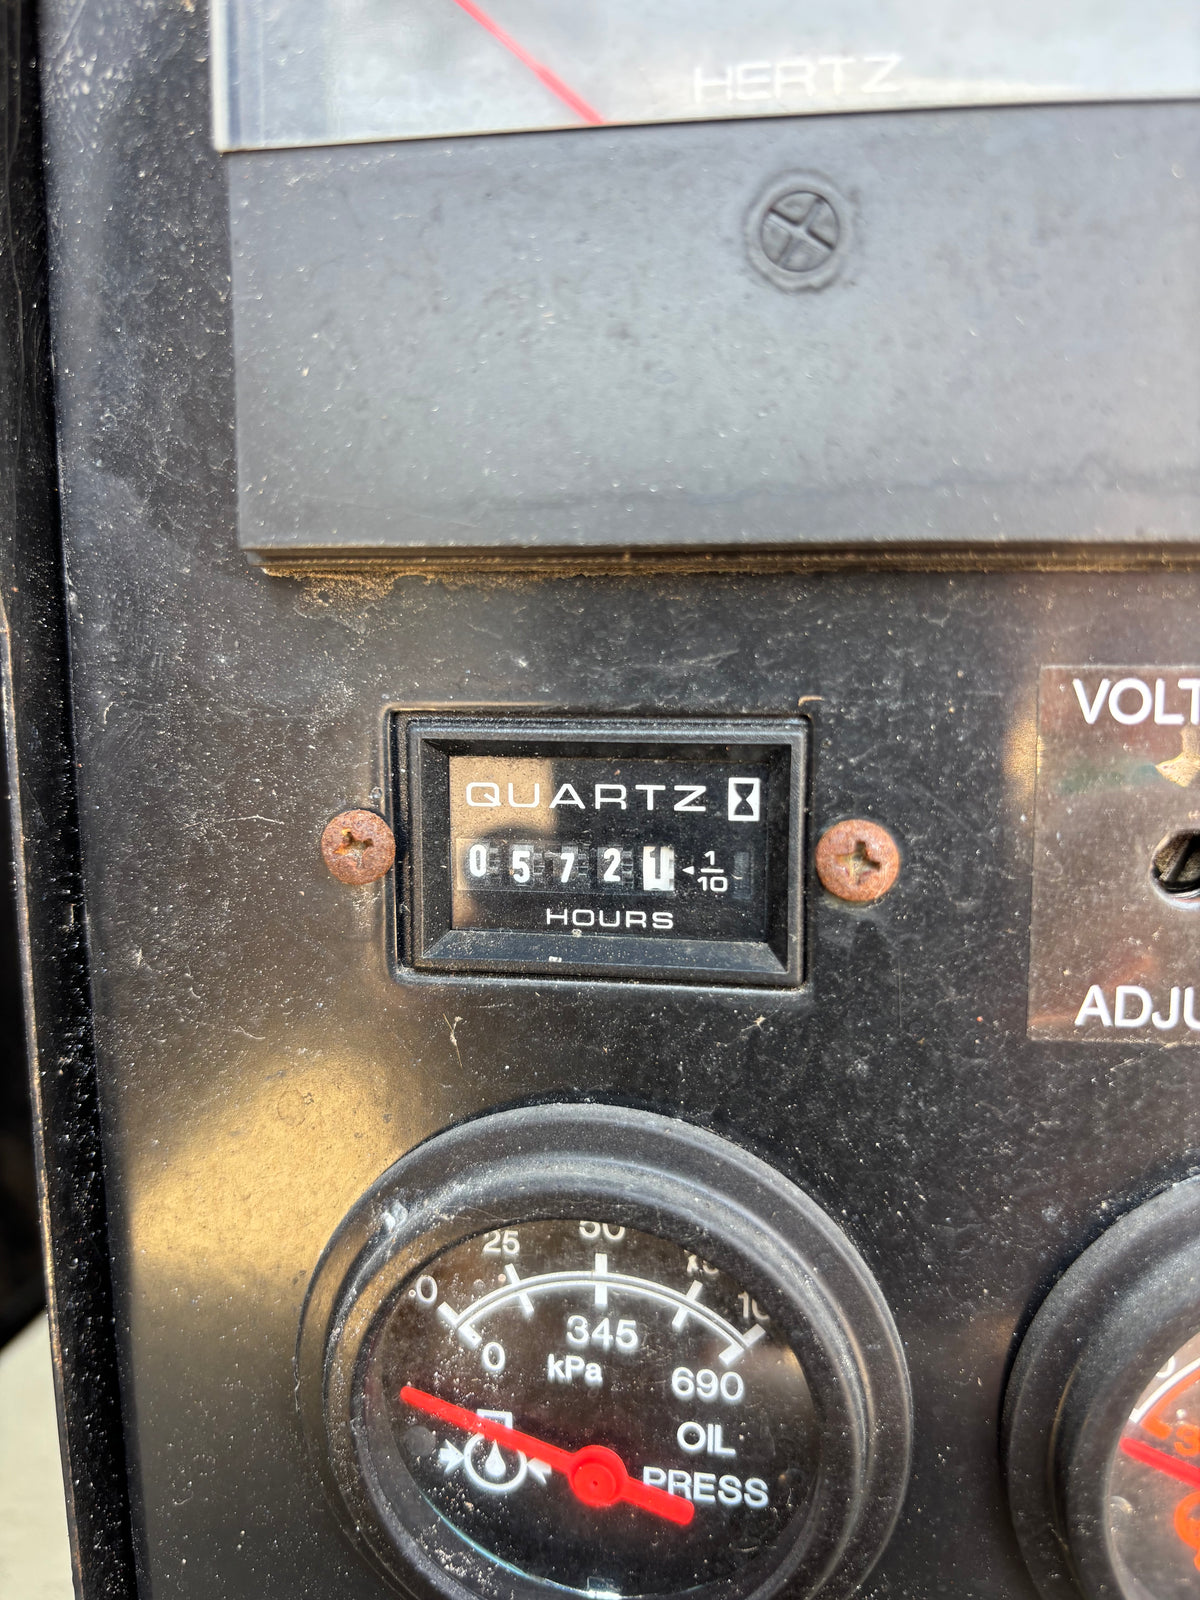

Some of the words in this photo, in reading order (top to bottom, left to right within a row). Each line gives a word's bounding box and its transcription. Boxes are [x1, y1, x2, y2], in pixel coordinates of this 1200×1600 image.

[694, 54, 902, 102] HERTZ
[466, 782, 707, 812] QUARTZ
[546, 908, 674, 929] HOURS
[483, 1230, 520, 1255] 25
[416, 1274, 438, 1304] 0
[566, 1315, 639, 1351] 345
[482, 1341, 506, 1371] 0
[547, 1354, 603, 1384] kPa
[671, 1366, 745, 1401] 690
[676, 1421, 736, 1457] OIL
[643, 1466, 769, 1508] PRESS
